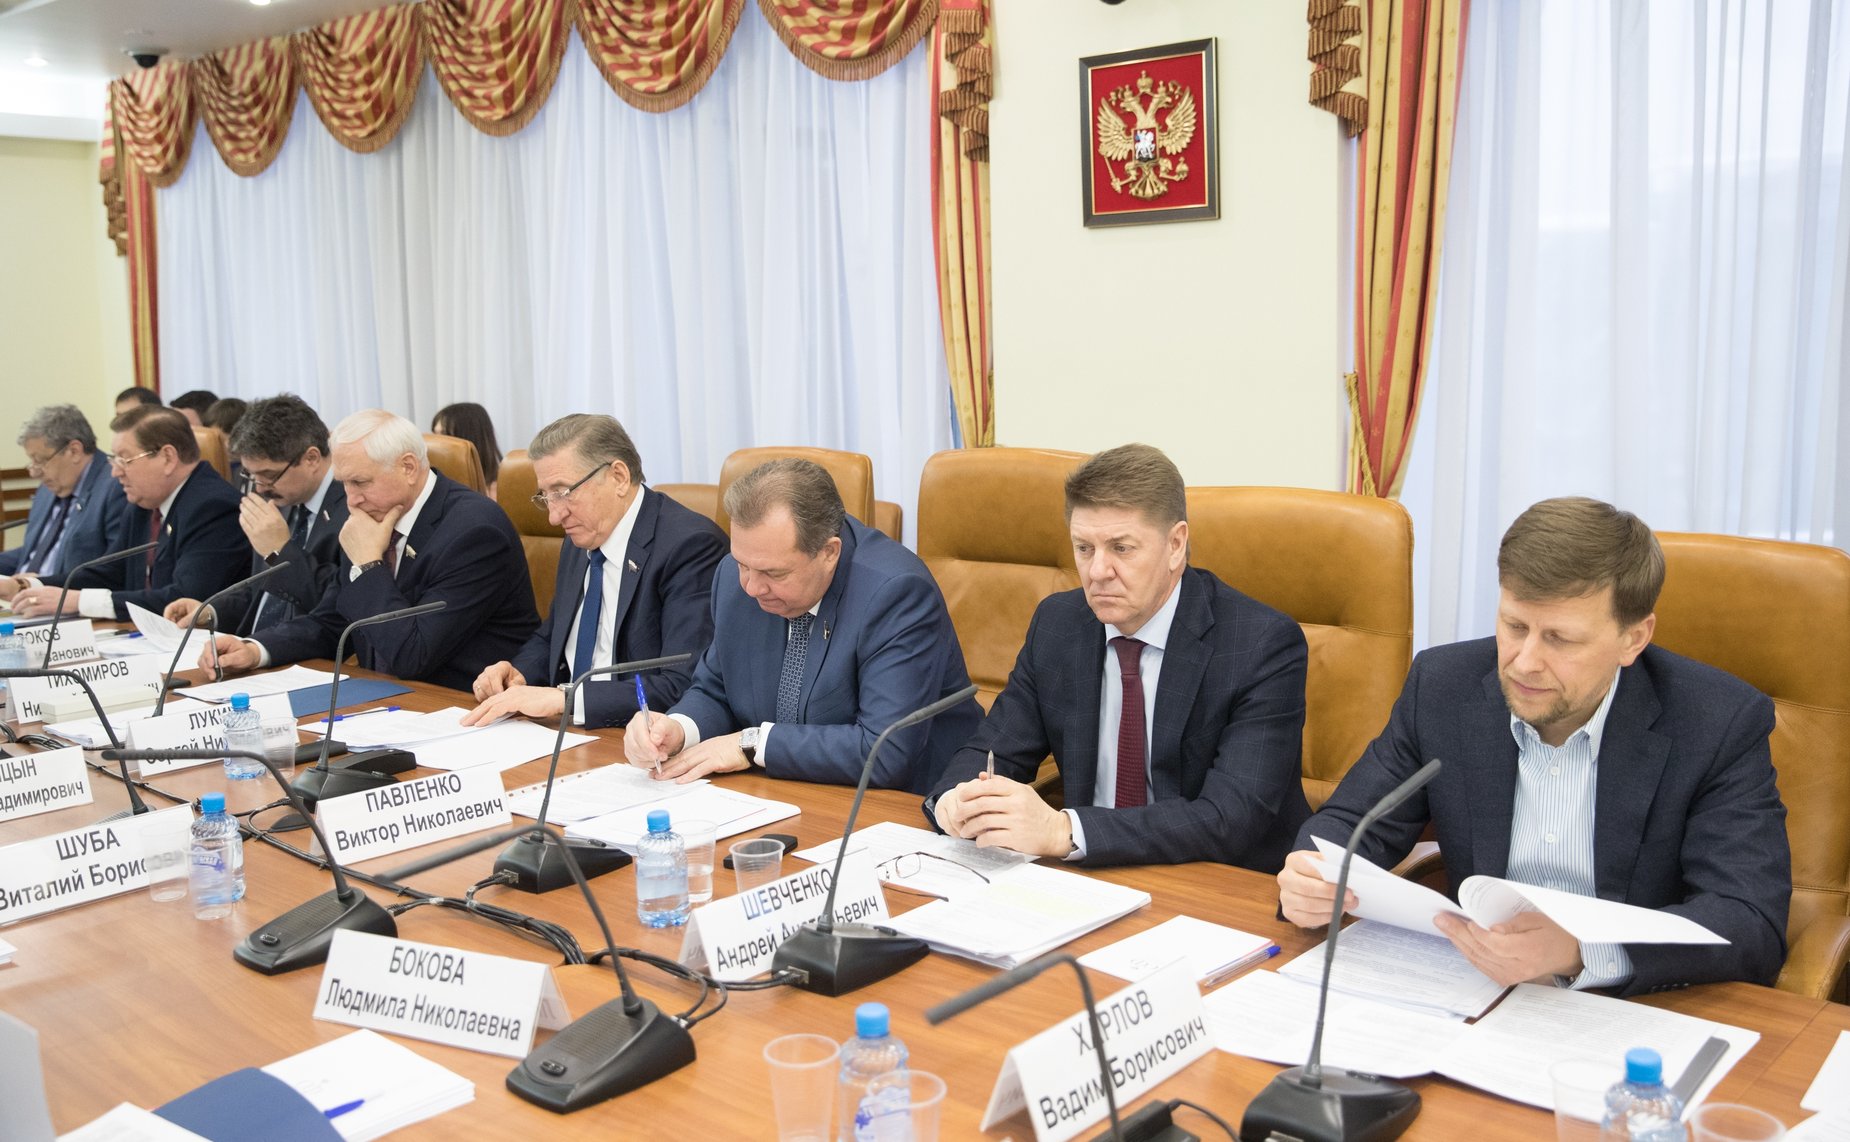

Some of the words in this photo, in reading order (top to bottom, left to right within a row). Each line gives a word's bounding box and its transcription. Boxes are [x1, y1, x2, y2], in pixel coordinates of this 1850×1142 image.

[0, 757, 38, 784] ЦЫН
[364, 772, 463, 813] ПАВЛЕНКО
[55, 827, 121, 861] ШУБА
[334, 817, 400, 852] Виктор
[404, 797, 504, 829] Николаевич
[741, 867, 834, 921] ШЕВЧЕНКО
[388, 945, 466, 987] БОКОВА
[716, 926, 779, 974] Андрей
[324, 977, 407, 1022] Людмила
[410, 994, 522, 1043] Николаевна
[1072, 989, 1154, 1056] ХРЛОВ
[1039, 1077, 1110, 1131] Вадим
[1108, 1015, 1208, 1089] Борисович
